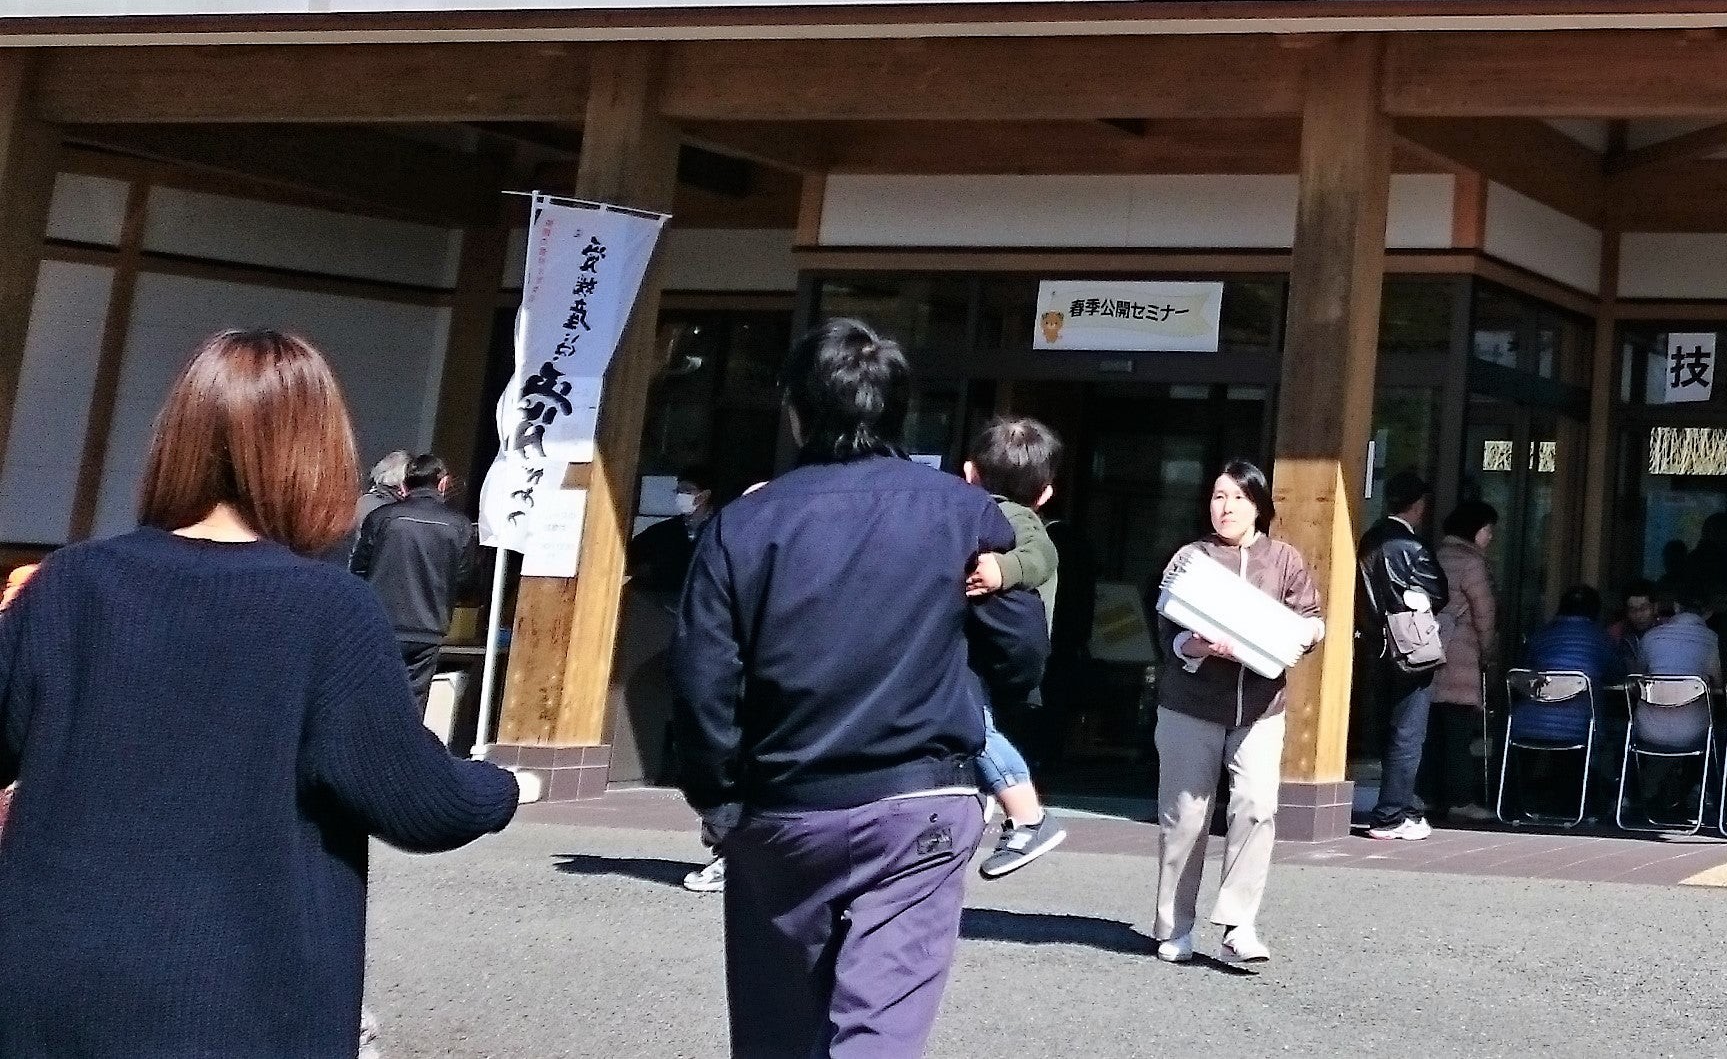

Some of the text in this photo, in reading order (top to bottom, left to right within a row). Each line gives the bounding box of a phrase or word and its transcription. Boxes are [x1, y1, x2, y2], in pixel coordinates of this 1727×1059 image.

[1069, 298, 1190, 322] 春季公開セミナー
[1670, 346, 1711, 389] 技
